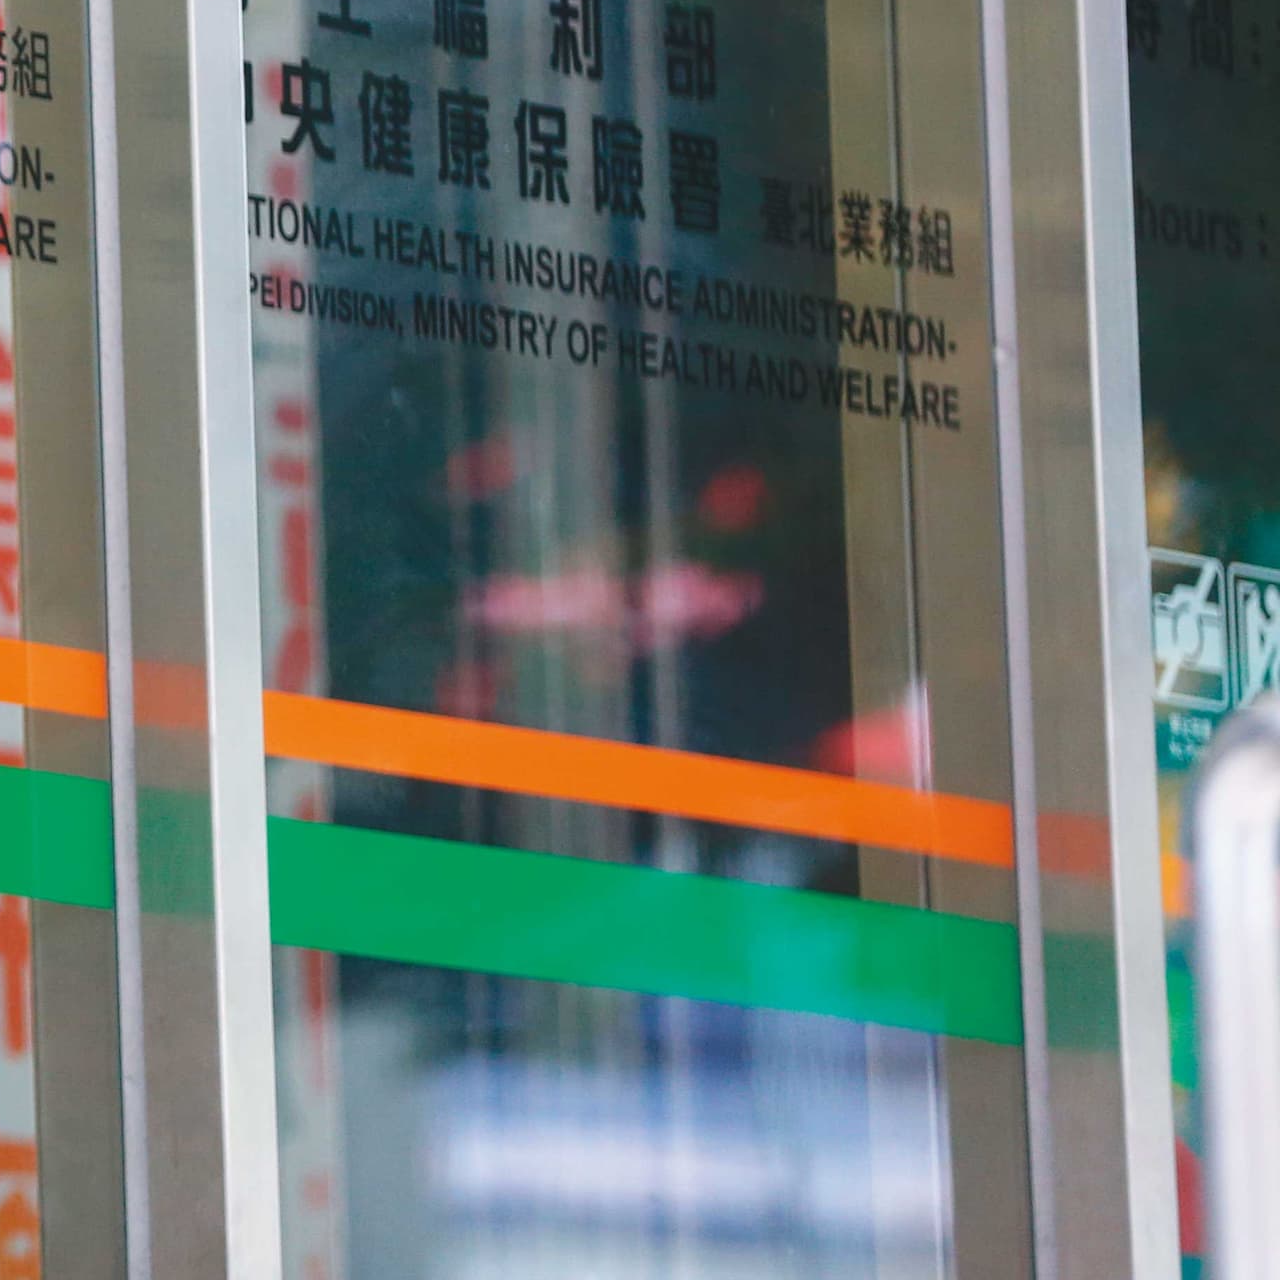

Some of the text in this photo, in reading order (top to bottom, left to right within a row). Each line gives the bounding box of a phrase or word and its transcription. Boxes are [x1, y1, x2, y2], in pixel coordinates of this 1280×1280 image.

[243, 60, 721, 234] 央健康保險署
[247, 194, 364, 257] TIONAL
[374, 217, 494, 281] HEALTH
[505, 243, 683, 312] INSURANCE
[290, 279, 404, 337] DIVISION,
[414, 291, 556, 358] MINISTRY
[568, 321, 608, 368] OF
[618, 332, 736, 387] HEALTH
[746, 356, 808, 401] AND
[816, 367, 960, 431] WELFARE
